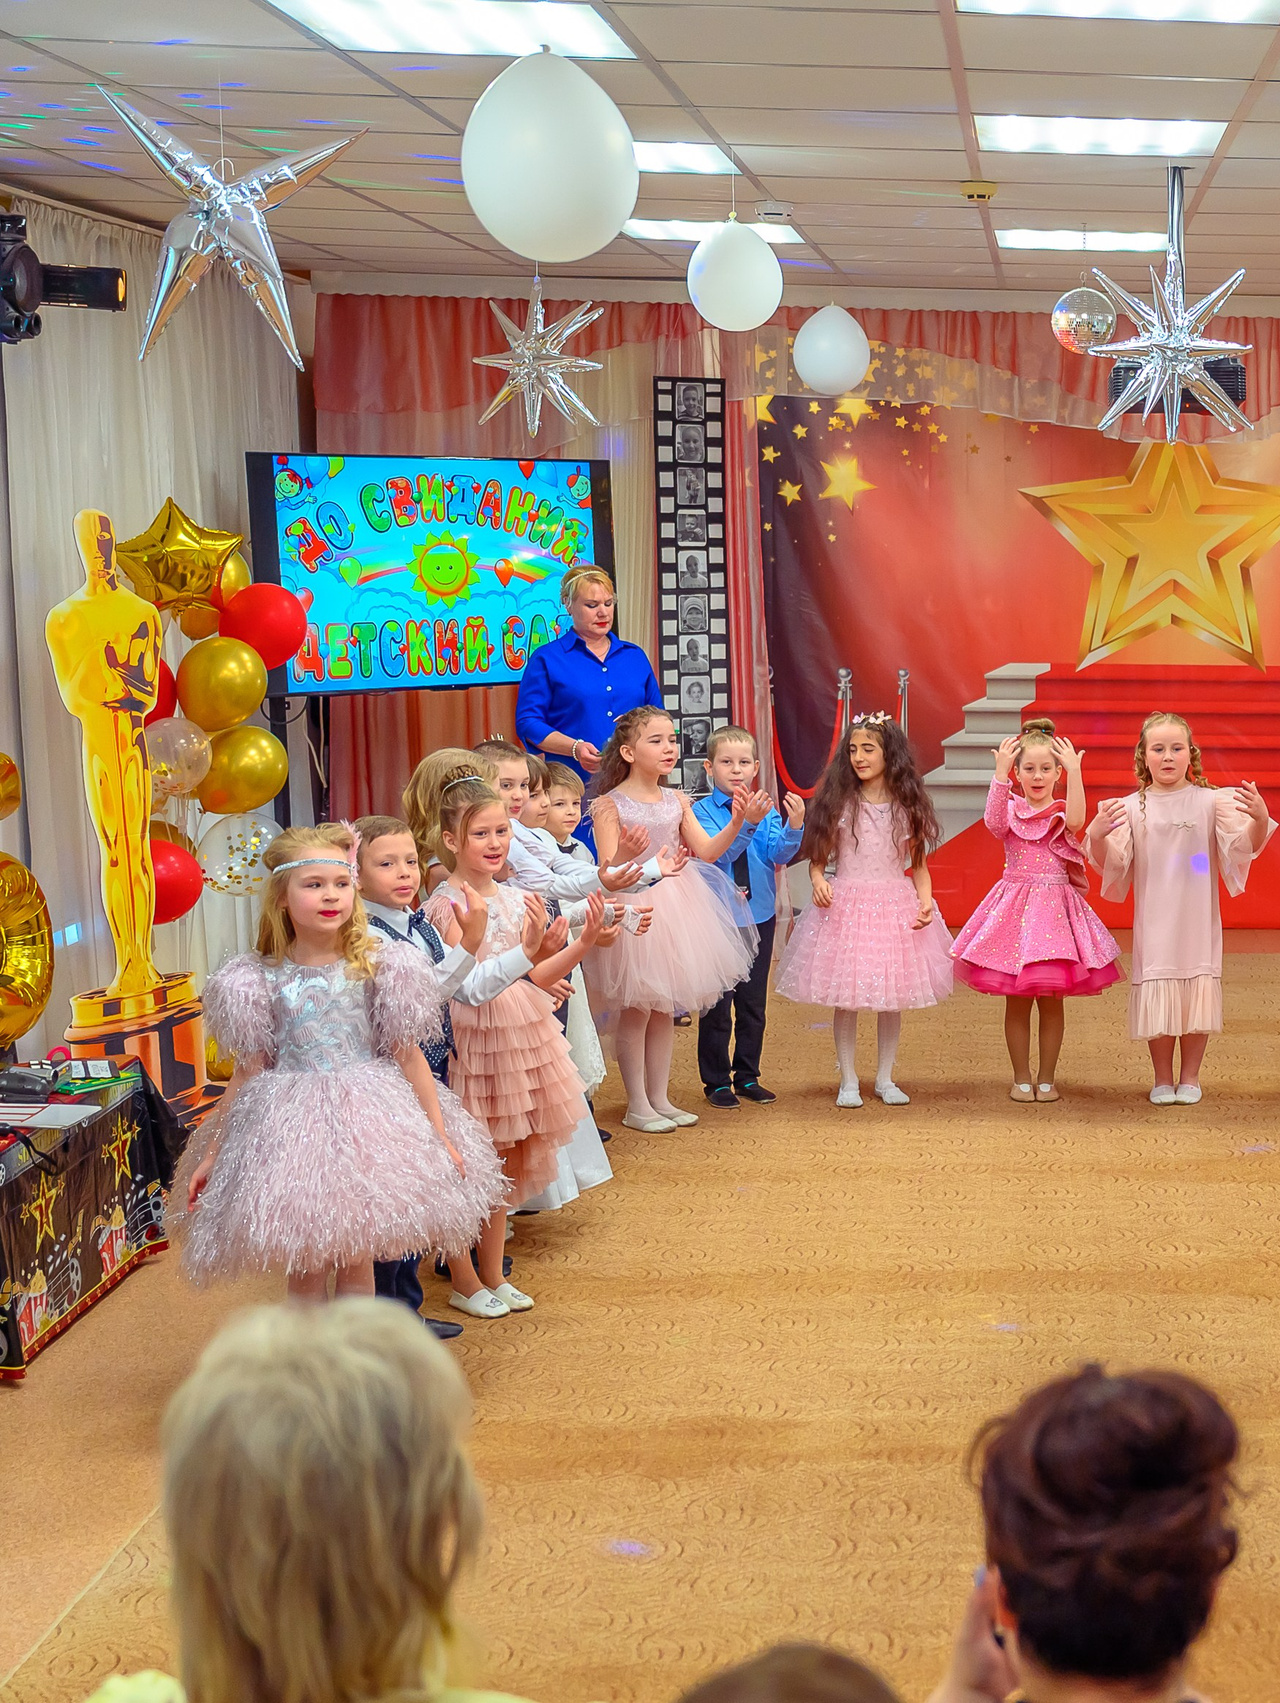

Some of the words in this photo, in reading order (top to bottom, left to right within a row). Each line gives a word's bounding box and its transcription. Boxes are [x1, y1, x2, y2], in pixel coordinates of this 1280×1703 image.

[285, 501, 354, 573] ДО
[359, 473, 590, 567] СВИДАНИЯ
[293, 616, 490, 683] ДЕТСКИЙ
[502, 613, 573, 671] СА
